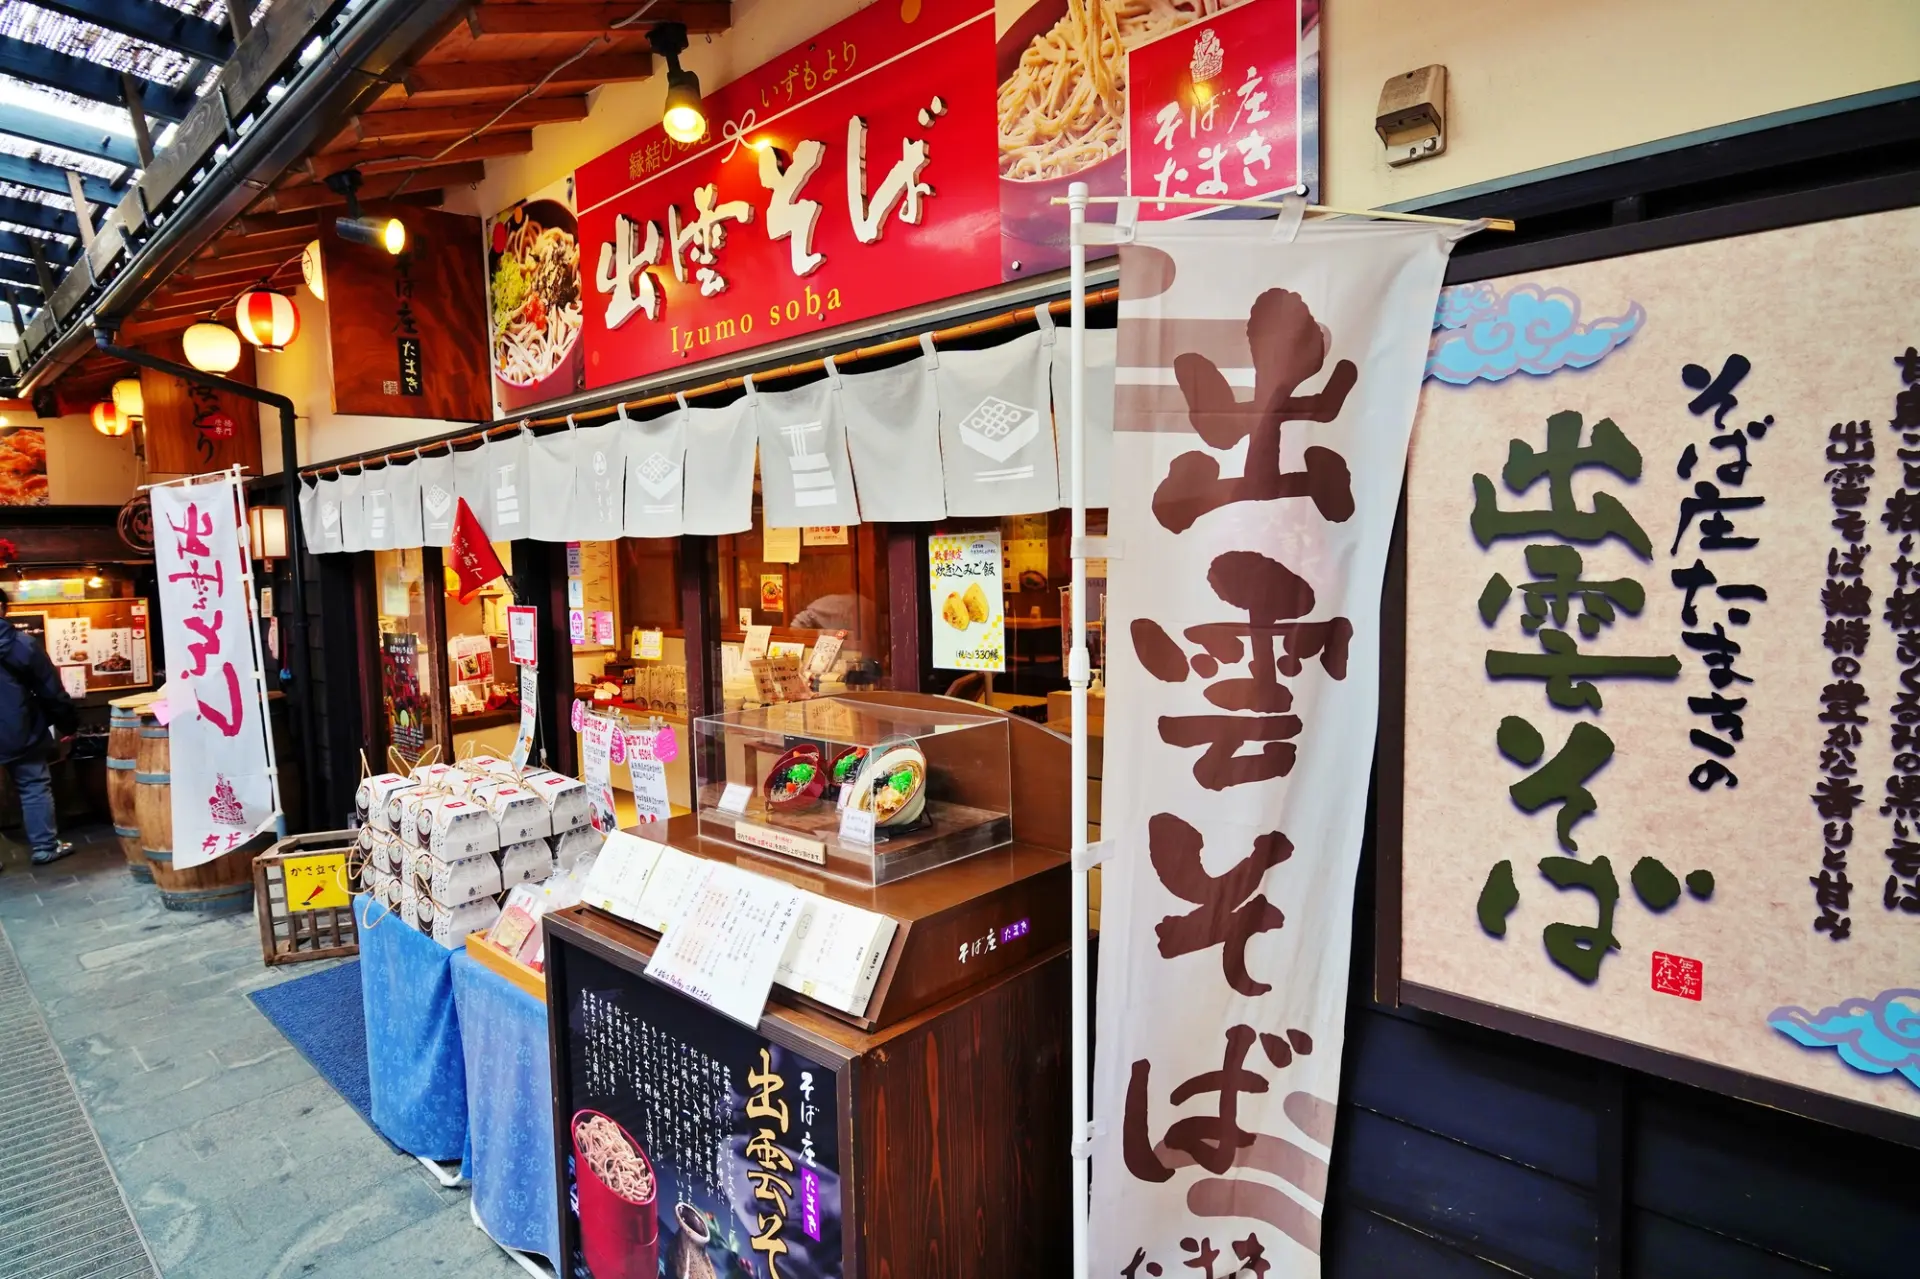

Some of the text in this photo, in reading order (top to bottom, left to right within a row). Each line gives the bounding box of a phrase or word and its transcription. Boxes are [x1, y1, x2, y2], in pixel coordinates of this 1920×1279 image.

[761, 41, 857, 107] いずもより
[1154, 66, 1270, 150] そば庄
[1153, 128, 1271, 211] たまき
[596, 95, 948, 331] 出雲そば
[670, 284, 842, 353] Izumo soba
[402, 341, 419, 393] たまき
[935, 560, 996, 577] 炊き込みご飯
[1671, 353, 1775, 790] そば庄たまきの
[1471, 409, 1715, 982] 出雲そば
[1120, 287, 1358, 1185] 出雲そば
[291, 865, 338, 876] かさ立て
[958, 928, 998, 964] そば庄
[1003, 920, 1028, 942] たまき
[798, 1072, 821, 1168] そば庄
[804, 1173, 818, 1233] たまき
